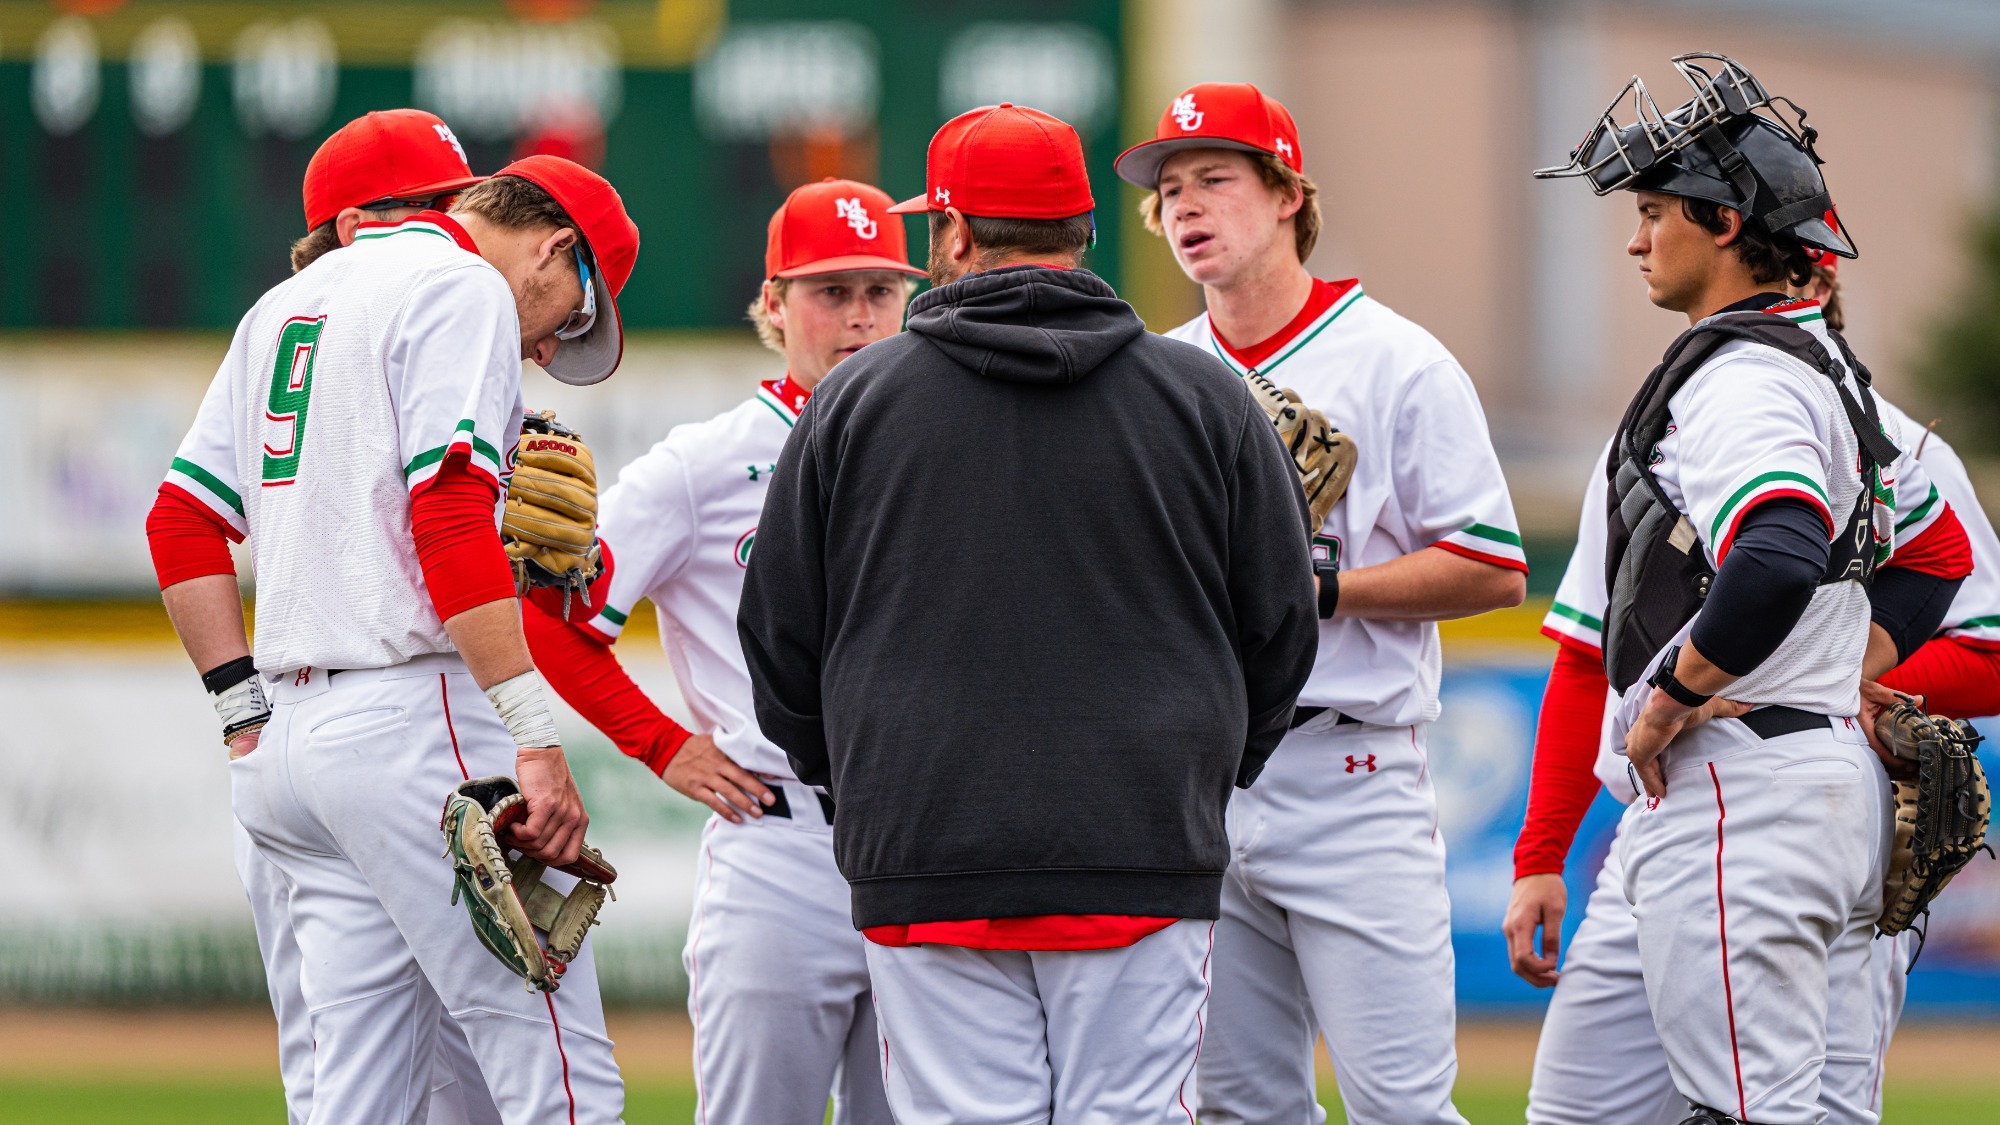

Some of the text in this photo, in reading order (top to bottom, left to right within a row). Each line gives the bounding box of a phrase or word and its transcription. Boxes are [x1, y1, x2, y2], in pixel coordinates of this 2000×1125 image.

[1171, 93, 1204, 132] MSU
[834, 197, 878, 240] MSU
[261, 314, 328, 487] 9
[525, 439, 578, 456] A2000
